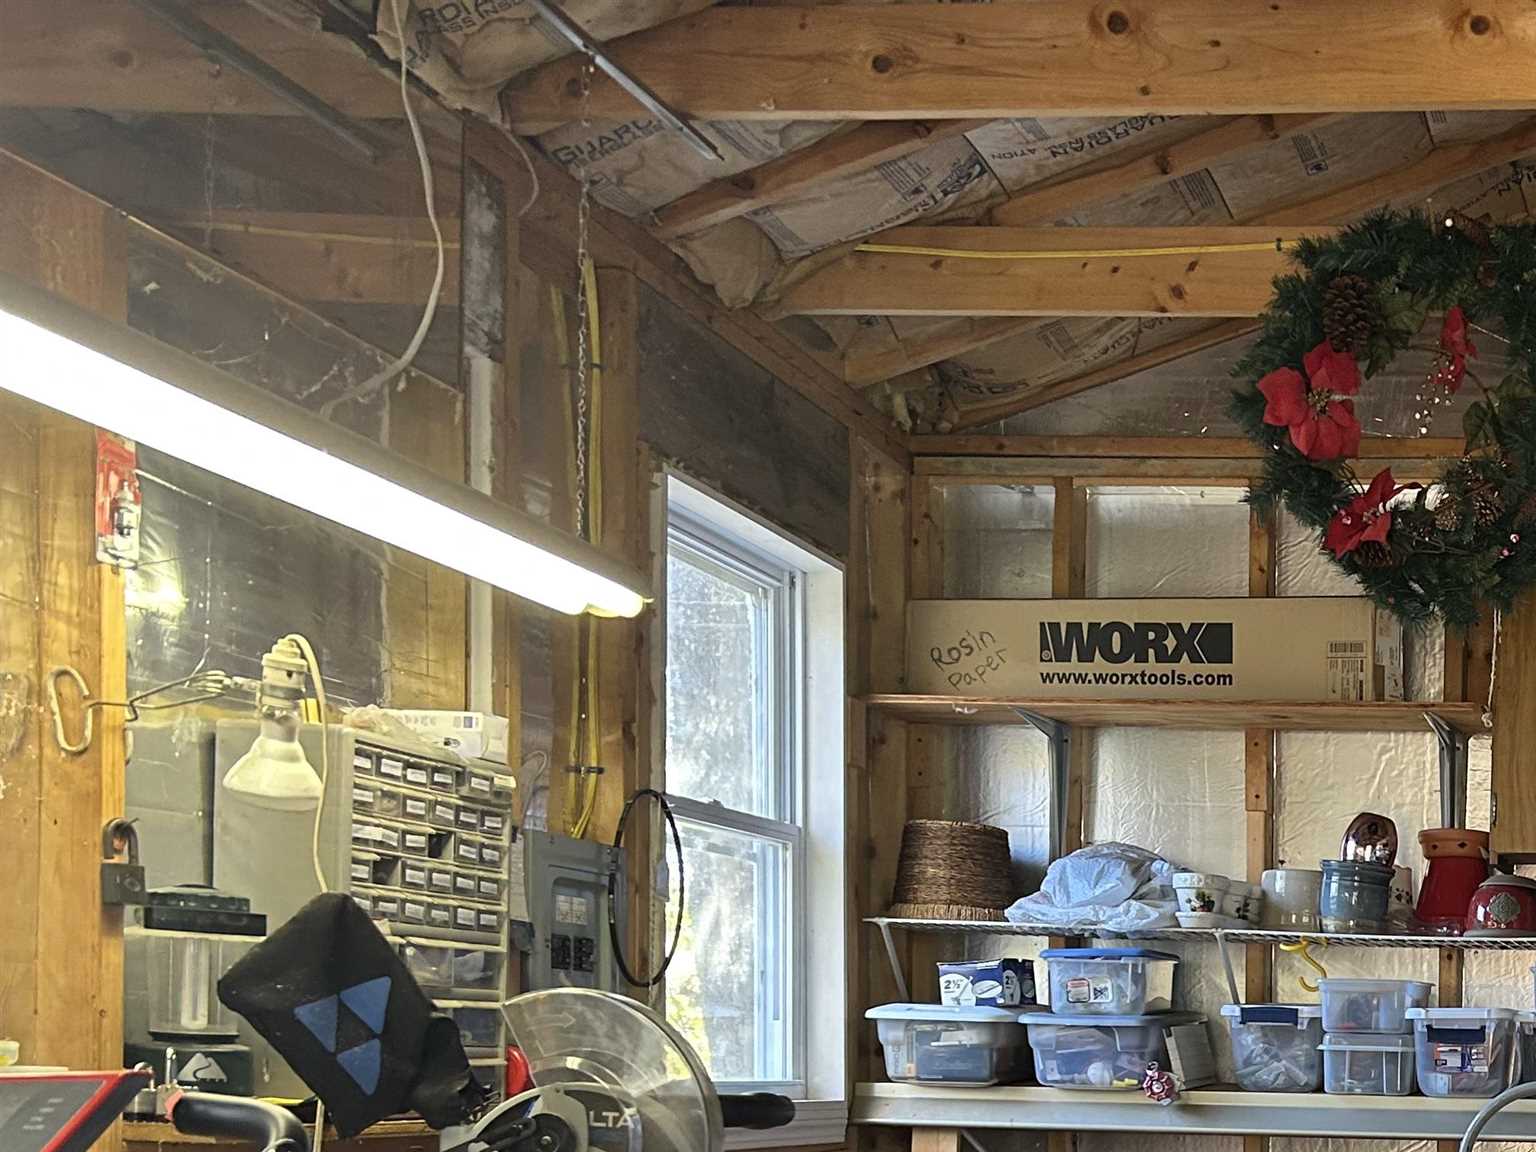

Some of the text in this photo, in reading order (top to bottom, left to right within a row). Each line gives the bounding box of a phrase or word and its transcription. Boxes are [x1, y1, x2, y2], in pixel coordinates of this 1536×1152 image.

[1049, 113, 1181, 158] UARDIAN
[1047, 621, 1207, 664] WORX
[1040, 669, 1233, 686] www.worxtools.com
[589, 1109, 634, 1128] LTA
